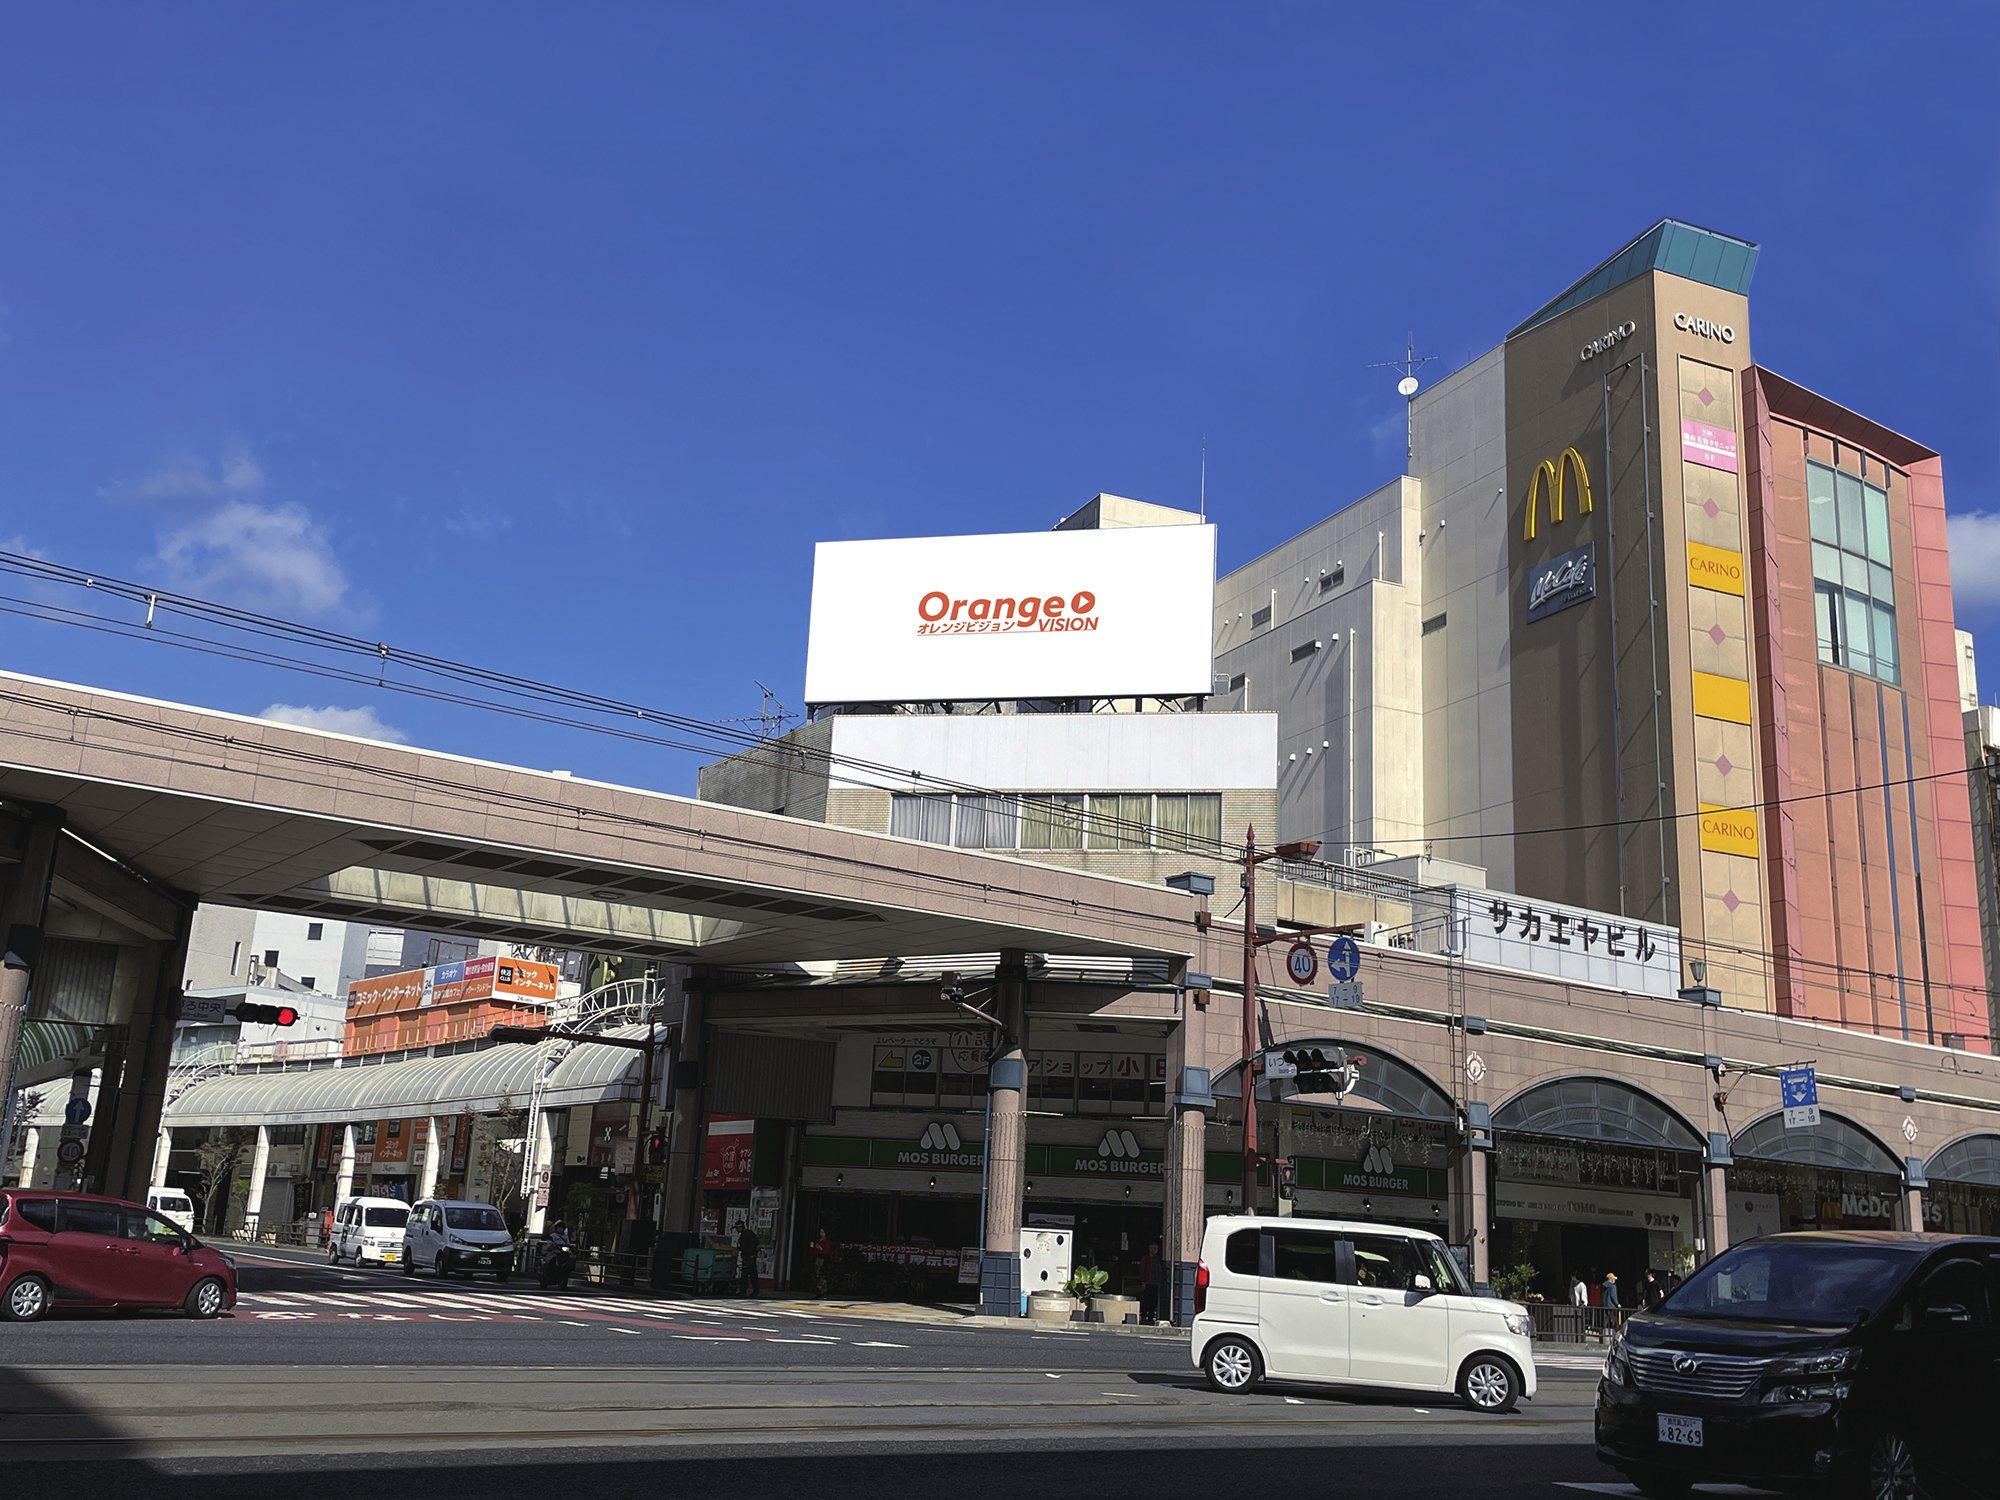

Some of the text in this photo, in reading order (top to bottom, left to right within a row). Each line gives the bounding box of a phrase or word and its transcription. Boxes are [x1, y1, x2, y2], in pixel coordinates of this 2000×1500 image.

[1674, 312, 1735, 343] CARINO
[1580, 320, 1636, 360] CARINO
[1690, 557, 1740, 579] CARINO
[918, 591, 1065, 627] Orange
[917, 616, 1099, 634] オレンジビジョン VISION
[1703, 819, 1754, 840] CARINO
[1488, 900, 1656, 962] サカエヤビル
[1294, 956, 1311, 973] 40
[441, 969, 458, 980] カラオケ
[513, 979, 554, 991] インターネット
[184, 1000, 221, 1013] ろ中央
[913, 1054, 930, 1066] 2F
[897, 1152, 984, 1167] MOS BURGER
[1075, 1159, 1164, 1174] MOS BURGER
[1343, 1174, 1409, 1190] MOS BURGER
[1668, 1427, 1701, 1444] 82-69
